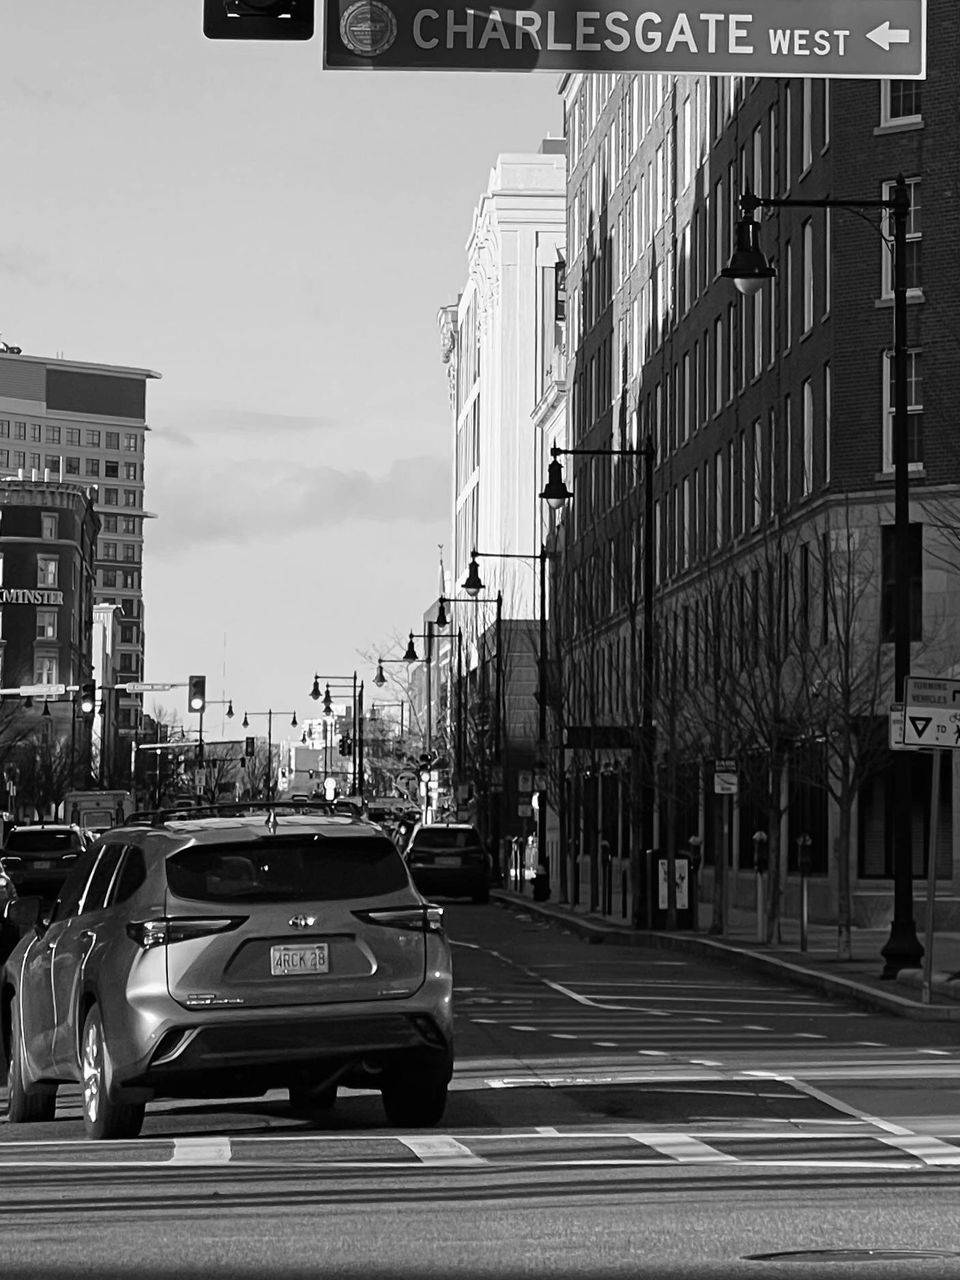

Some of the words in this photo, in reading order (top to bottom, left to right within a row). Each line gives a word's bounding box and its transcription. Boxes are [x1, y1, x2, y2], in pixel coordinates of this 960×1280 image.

[412, 7, 754, 55] CHARLESGATE
[769, 28, 850, 57] WEST
[0, 588, 63, 606] MINSTER
[913, 681, 948, 691] TURNING
[911, 694, 947, 704] VEHICLES
[936, 724, 947, 733] TO
